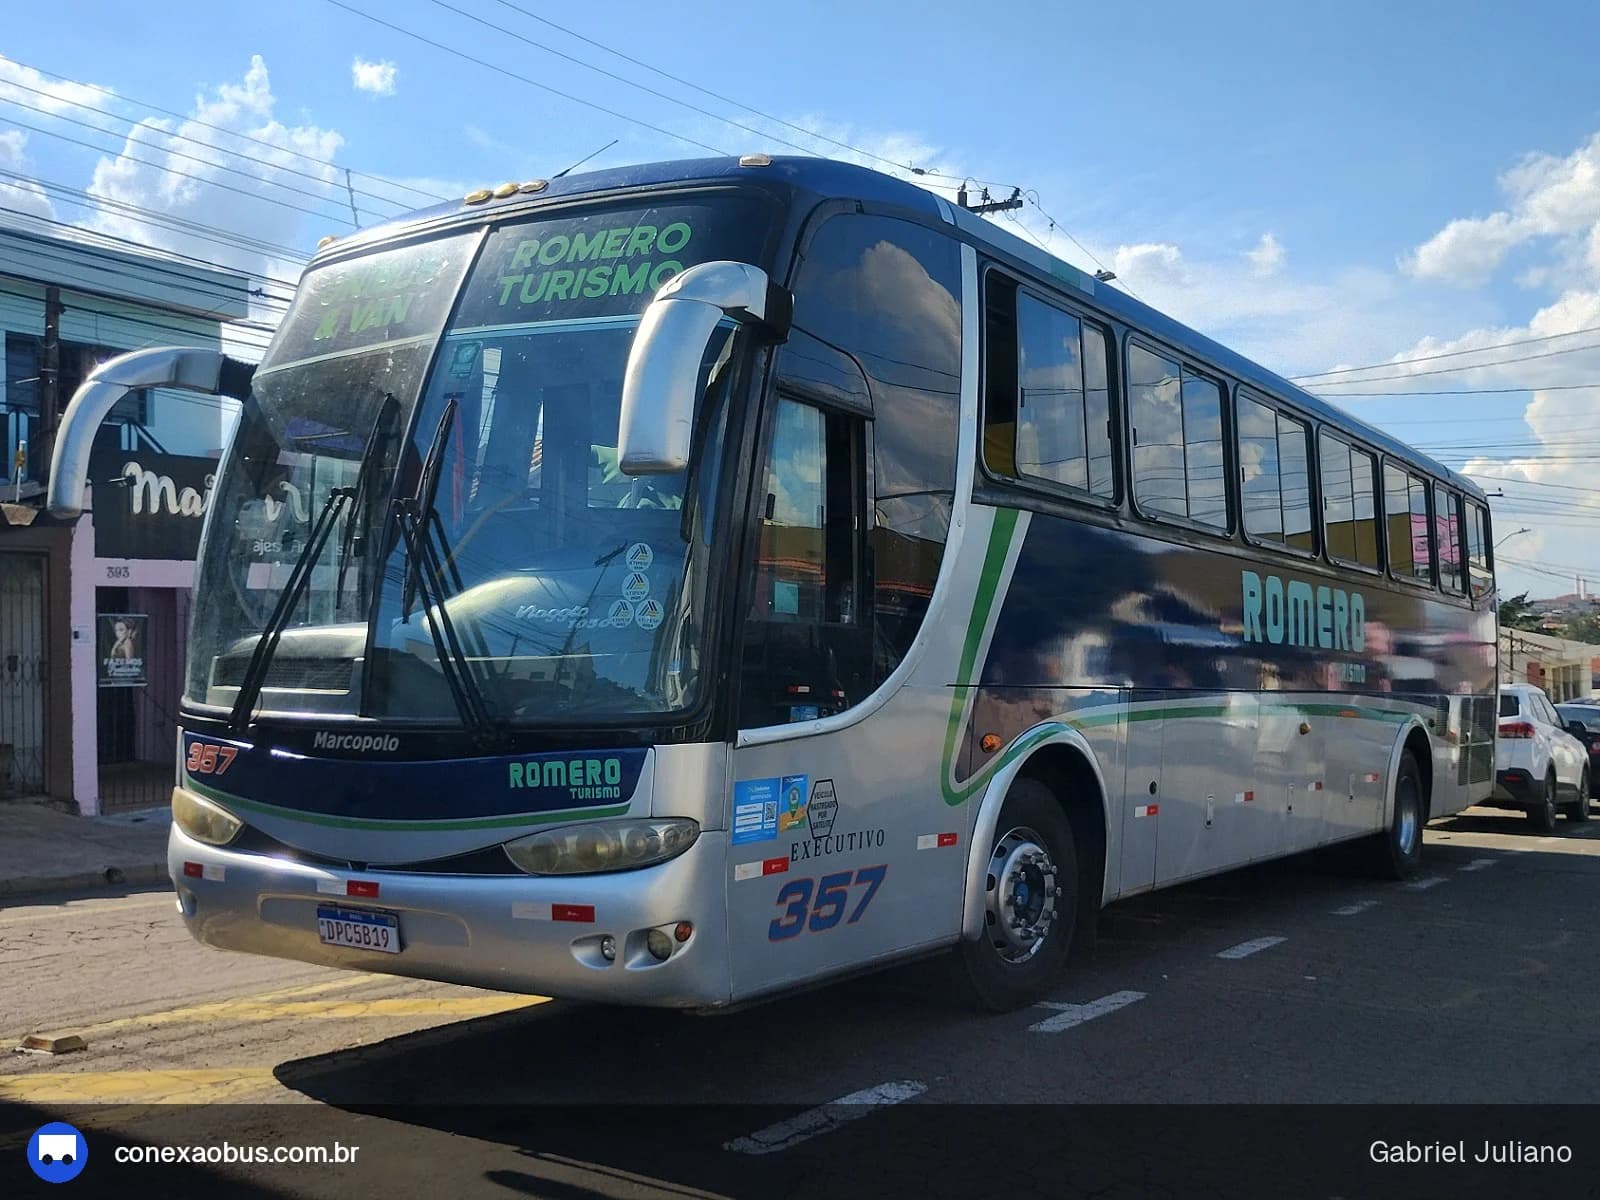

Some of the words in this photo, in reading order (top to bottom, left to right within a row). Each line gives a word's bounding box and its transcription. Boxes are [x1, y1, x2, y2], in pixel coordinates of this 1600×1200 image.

[510, 222, 692, 269] ROMERO
[498, 260, 685, 307] TURISMO
[348, 294, 414, 334] VAN
[106, 566, 131, 580] 393
[516, 604, 589, 624] Viaggio
[1241, 569, 1366, 654] ROMERO
[313, 730, 400, 753] Marcopolo
[509, 757, 621, 789] ROMERO
[569, 786, 621, 801] TURISMO
[790, 829, 886, 862] EXECUTIVO
[767, 864, 889, 943] 357
[326, 920, 390, 949] DPC5B19
